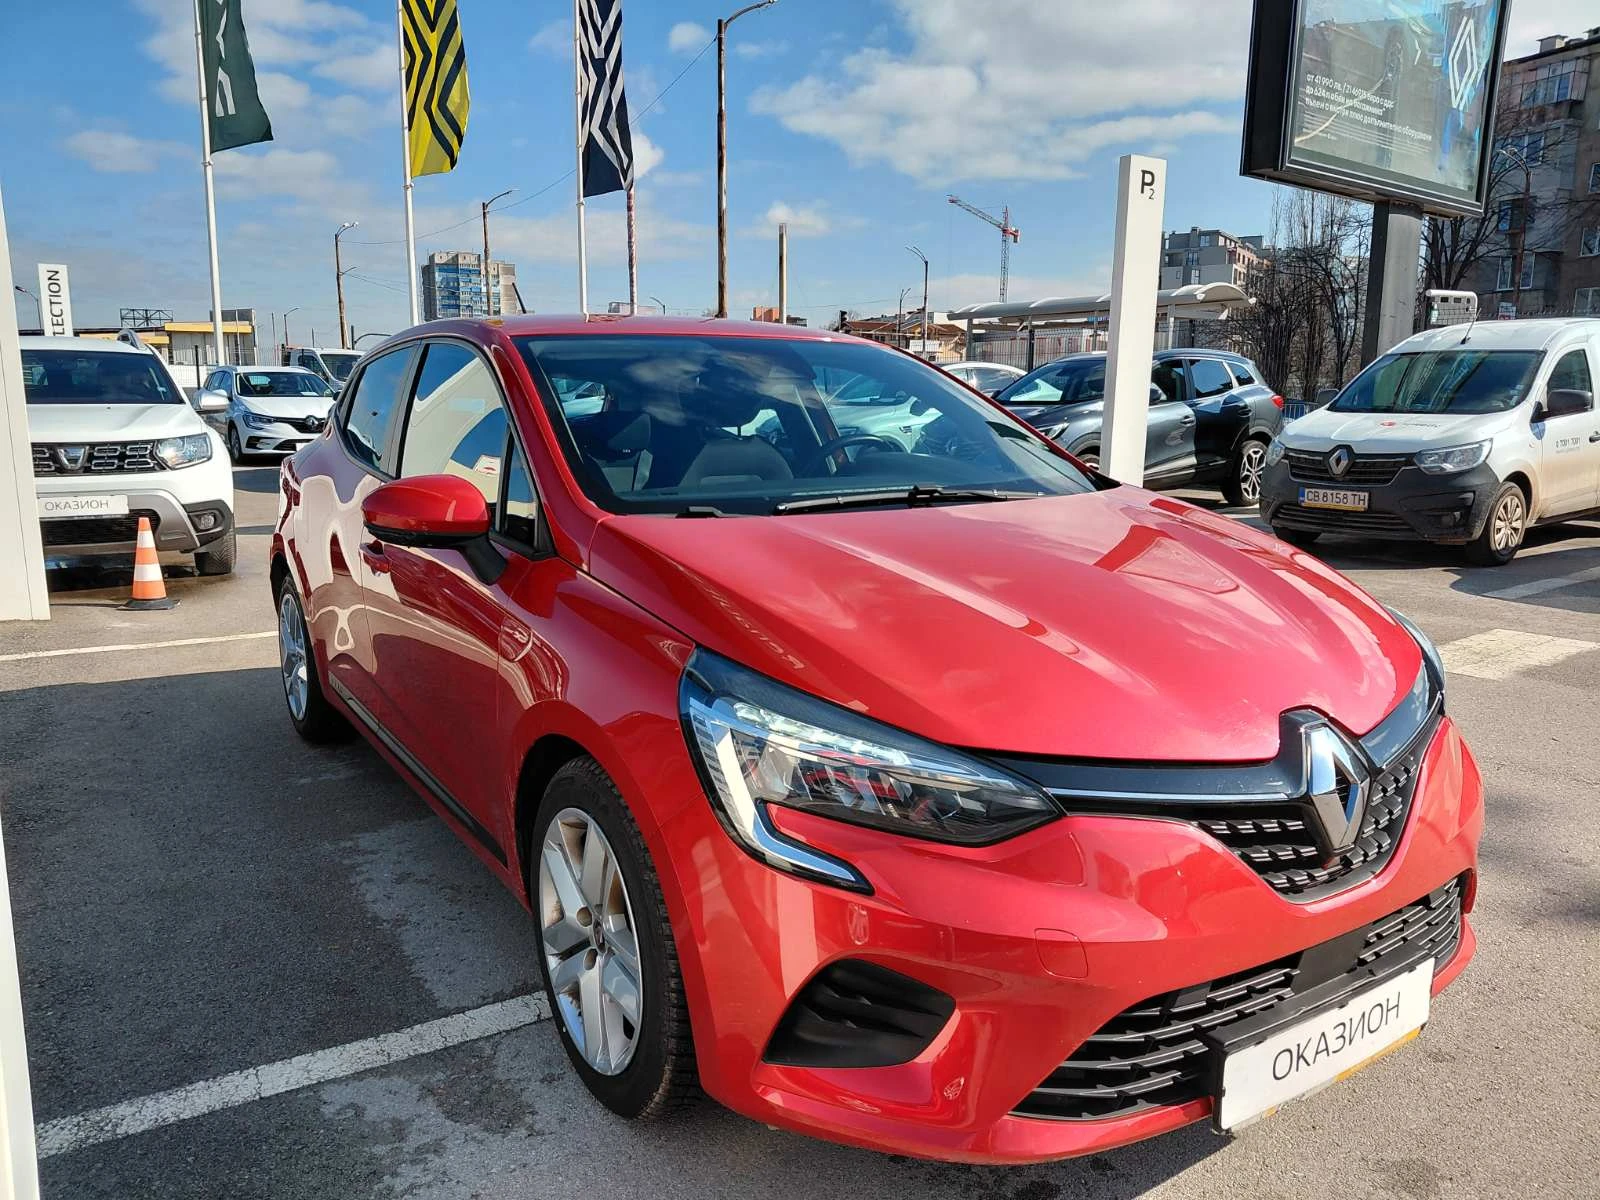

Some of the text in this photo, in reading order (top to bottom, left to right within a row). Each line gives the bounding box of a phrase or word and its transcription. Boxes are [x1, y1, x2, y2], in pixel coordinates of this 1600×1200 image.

[1322, 491, 1349, 504] 8158
[44, 499, 109, 511] ОКАЗИОН
[1272, 991, 1400, 1081] ОКАЗИОН
